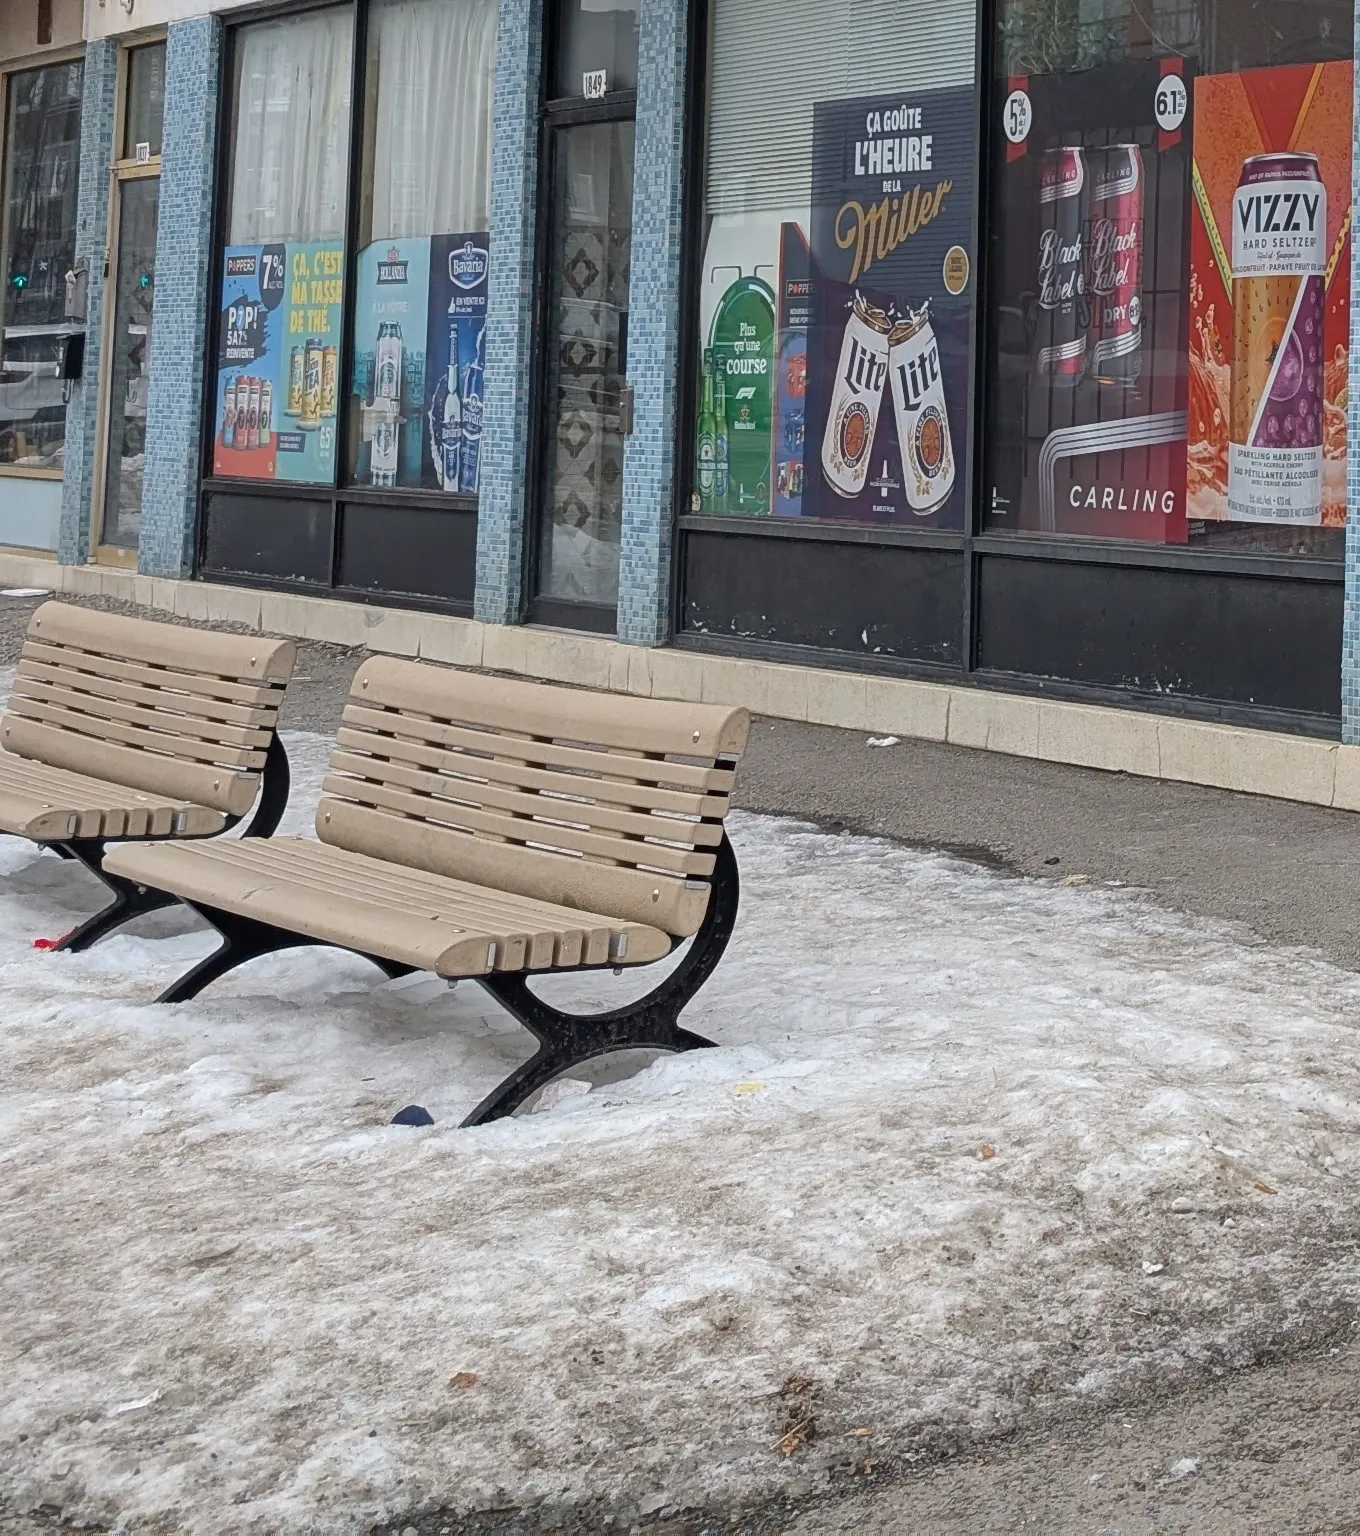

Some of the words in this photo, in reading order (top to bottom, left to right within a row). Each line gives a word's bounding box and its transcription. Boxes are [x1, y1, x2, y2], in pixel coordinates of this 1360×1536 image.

[585, 74, 603, 95] 1849
[866, 111, 881, 137] ÇA
[883, 104, 922, 132] GOÛTE
[854, 135, 932, 175] L'HEURE
[883, 181, 892, 192] DE
[892, 180, 901, 192] LA
[1238, 193, 1320, 234] VIZZY
[835, 180, 953, 284] Miller
[1090, 218, 1138, 259] Black
[1243, 239, 1268, 251] HARD
[1272, 237, 1315, 248] SELTZER
[1039, 227, 1082, 272] Black
[263, 254, 284, 290] 7%
[453, 257, 484, 276] Bavaria
[291, 281, 308, 305] MA
[290, 309, 305, 334] DE
[1104, 305, 1128, 326] DRY
[739, 322, 757, 337] Plus
[734, 337, 761, 353] qu'une
[726, 358, 767, 375] course
[844, 336, 887, 395] Lite
[897, 346, 940, 411] Lite
[1069, 485, 1175, 514] CARLING
